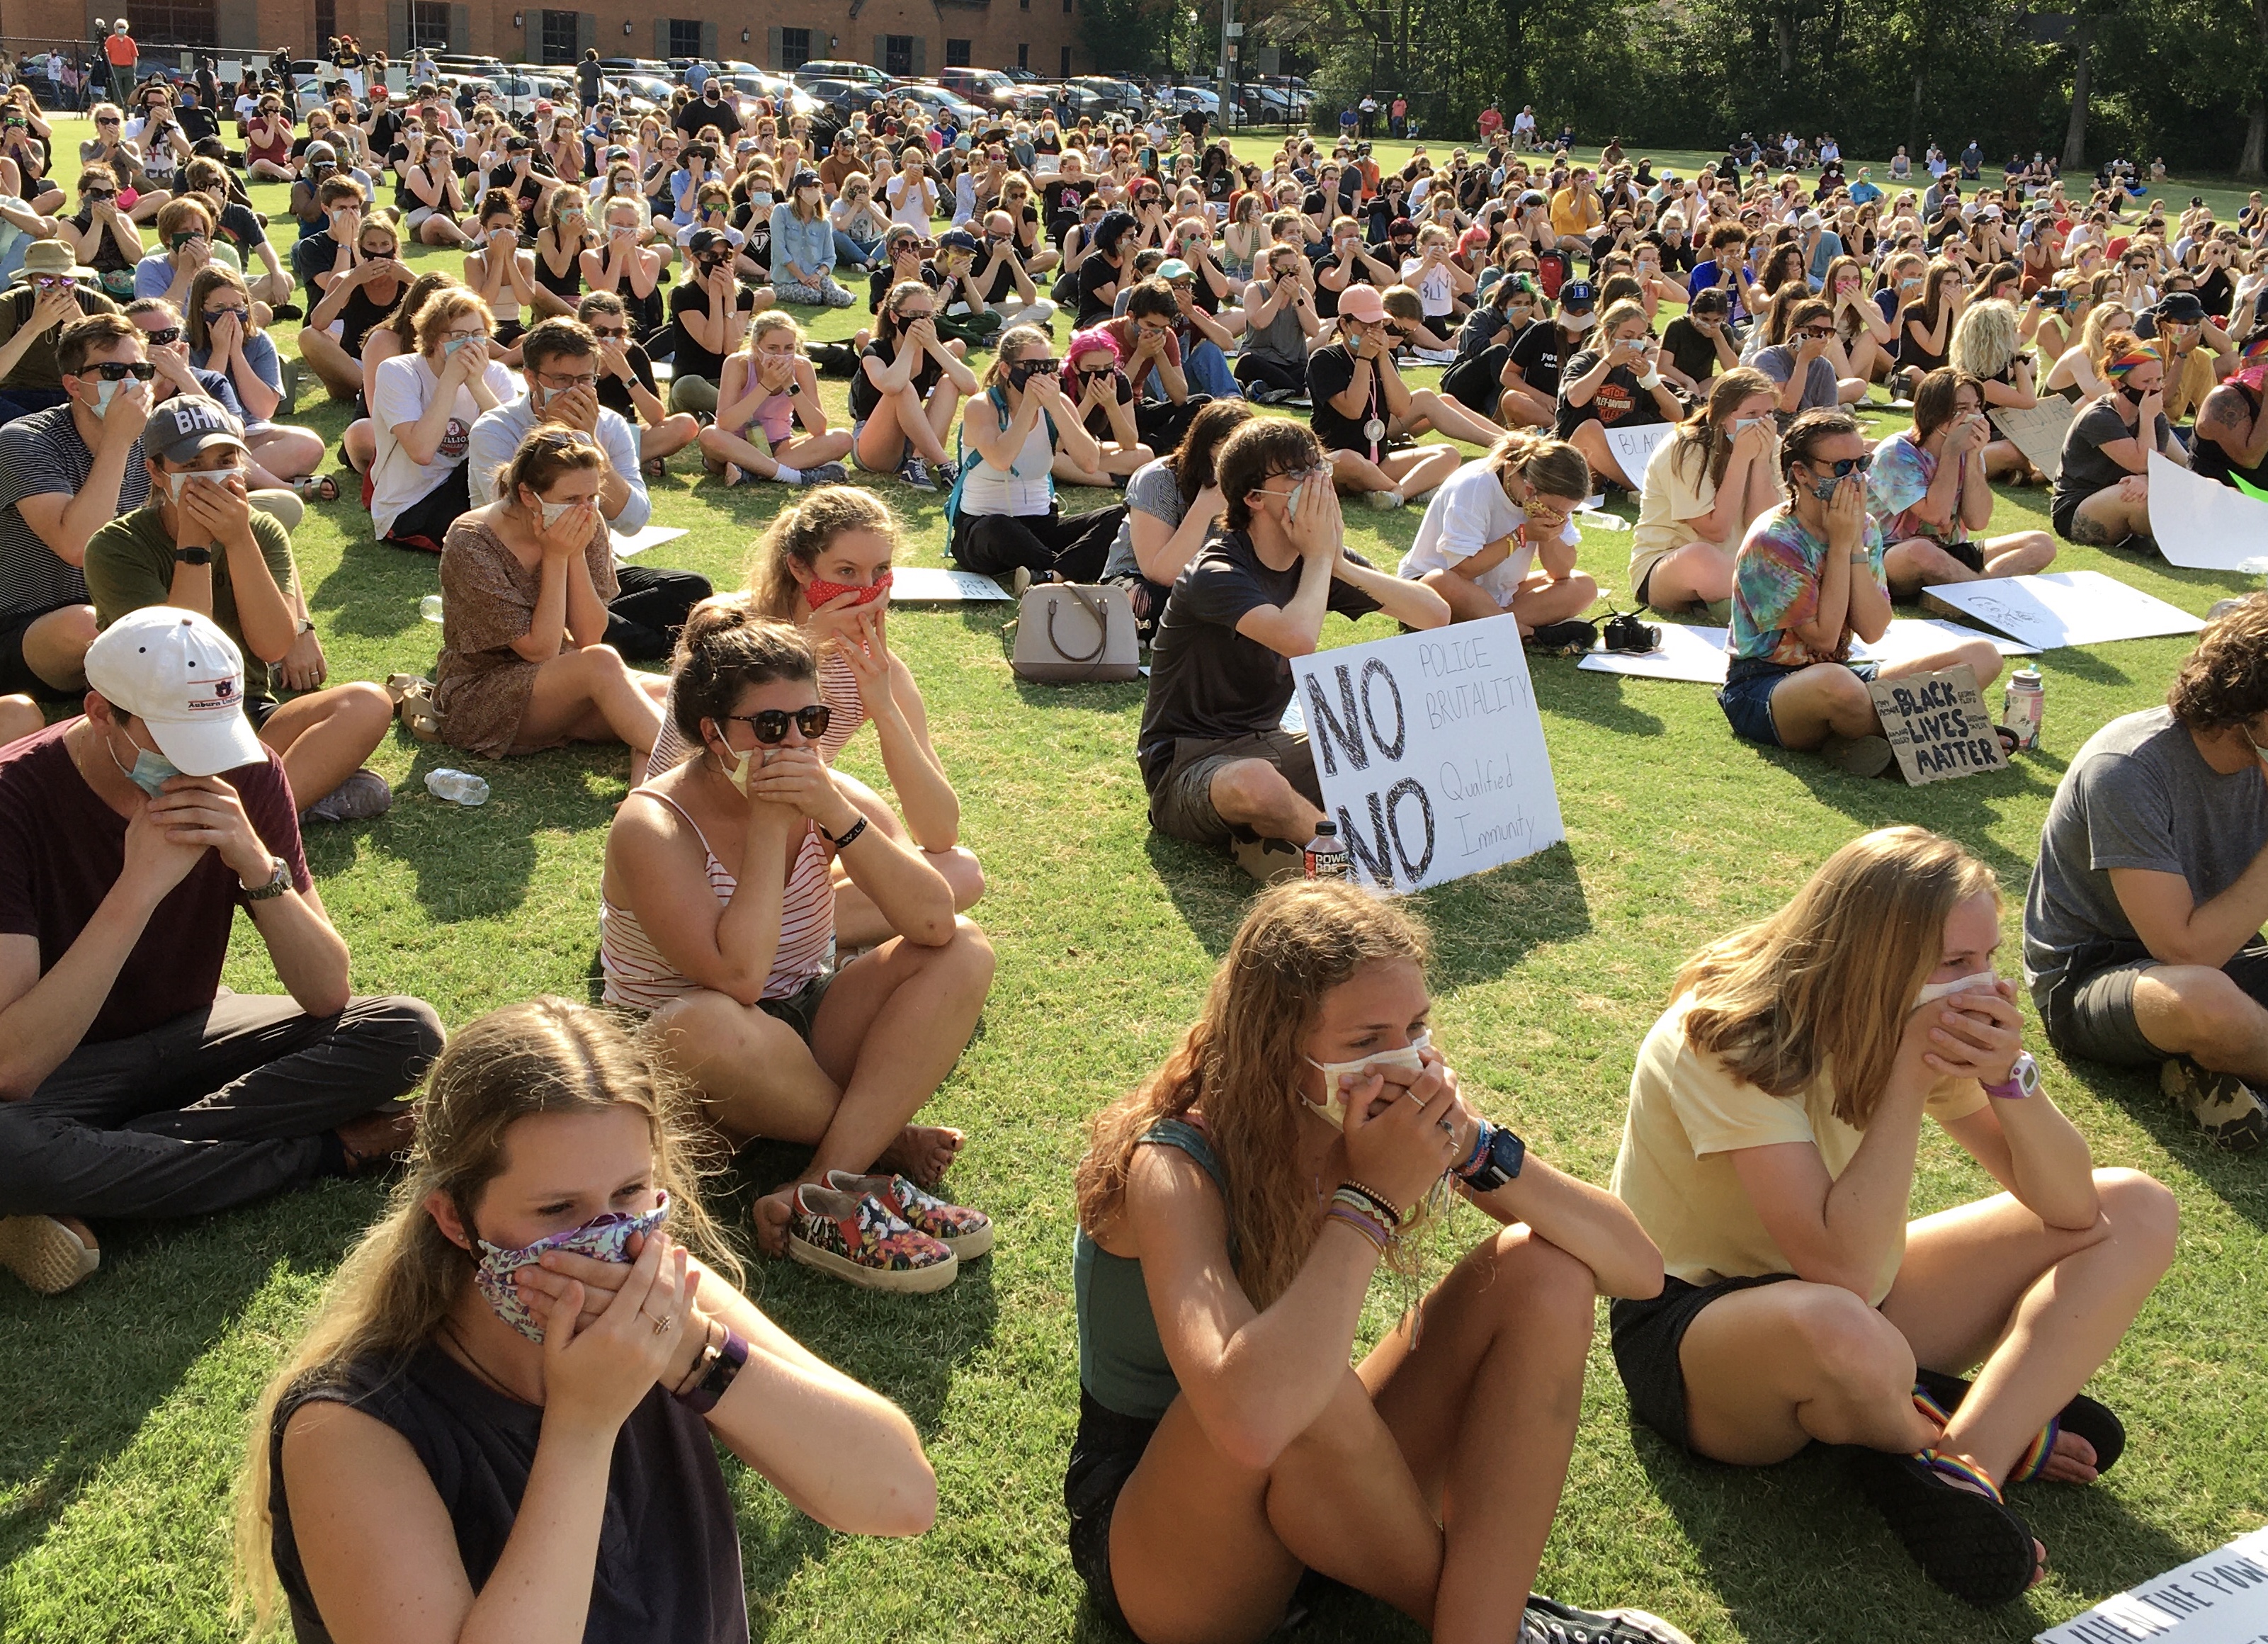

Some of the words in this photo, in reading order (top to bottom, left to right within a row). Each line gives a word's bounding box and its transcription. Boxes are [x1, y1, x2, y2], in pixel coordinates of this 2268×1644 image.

[754, 234, 766, 246] T
[174, 406, 229, 434] BHM
[1618, 432, 1664, 455] BLAC
[1419, 637, 1491, 677] POLICE
[1303, 657, 1406, 778] NO
[1426, 672, 1529, 730] BRUTALITY
[1892, 681, 1958, 718] BLACK
[1905, 708, 1970, 744] LIVES
[1915, 738, 1998, 776] MATTER
[1439, 753, 1514, 802] Qualified
[1336, 776, 1435, 890] NO
[1454, 804, 1536, 857] Immunity
[2137, 1583, 2214, 1621] THE
